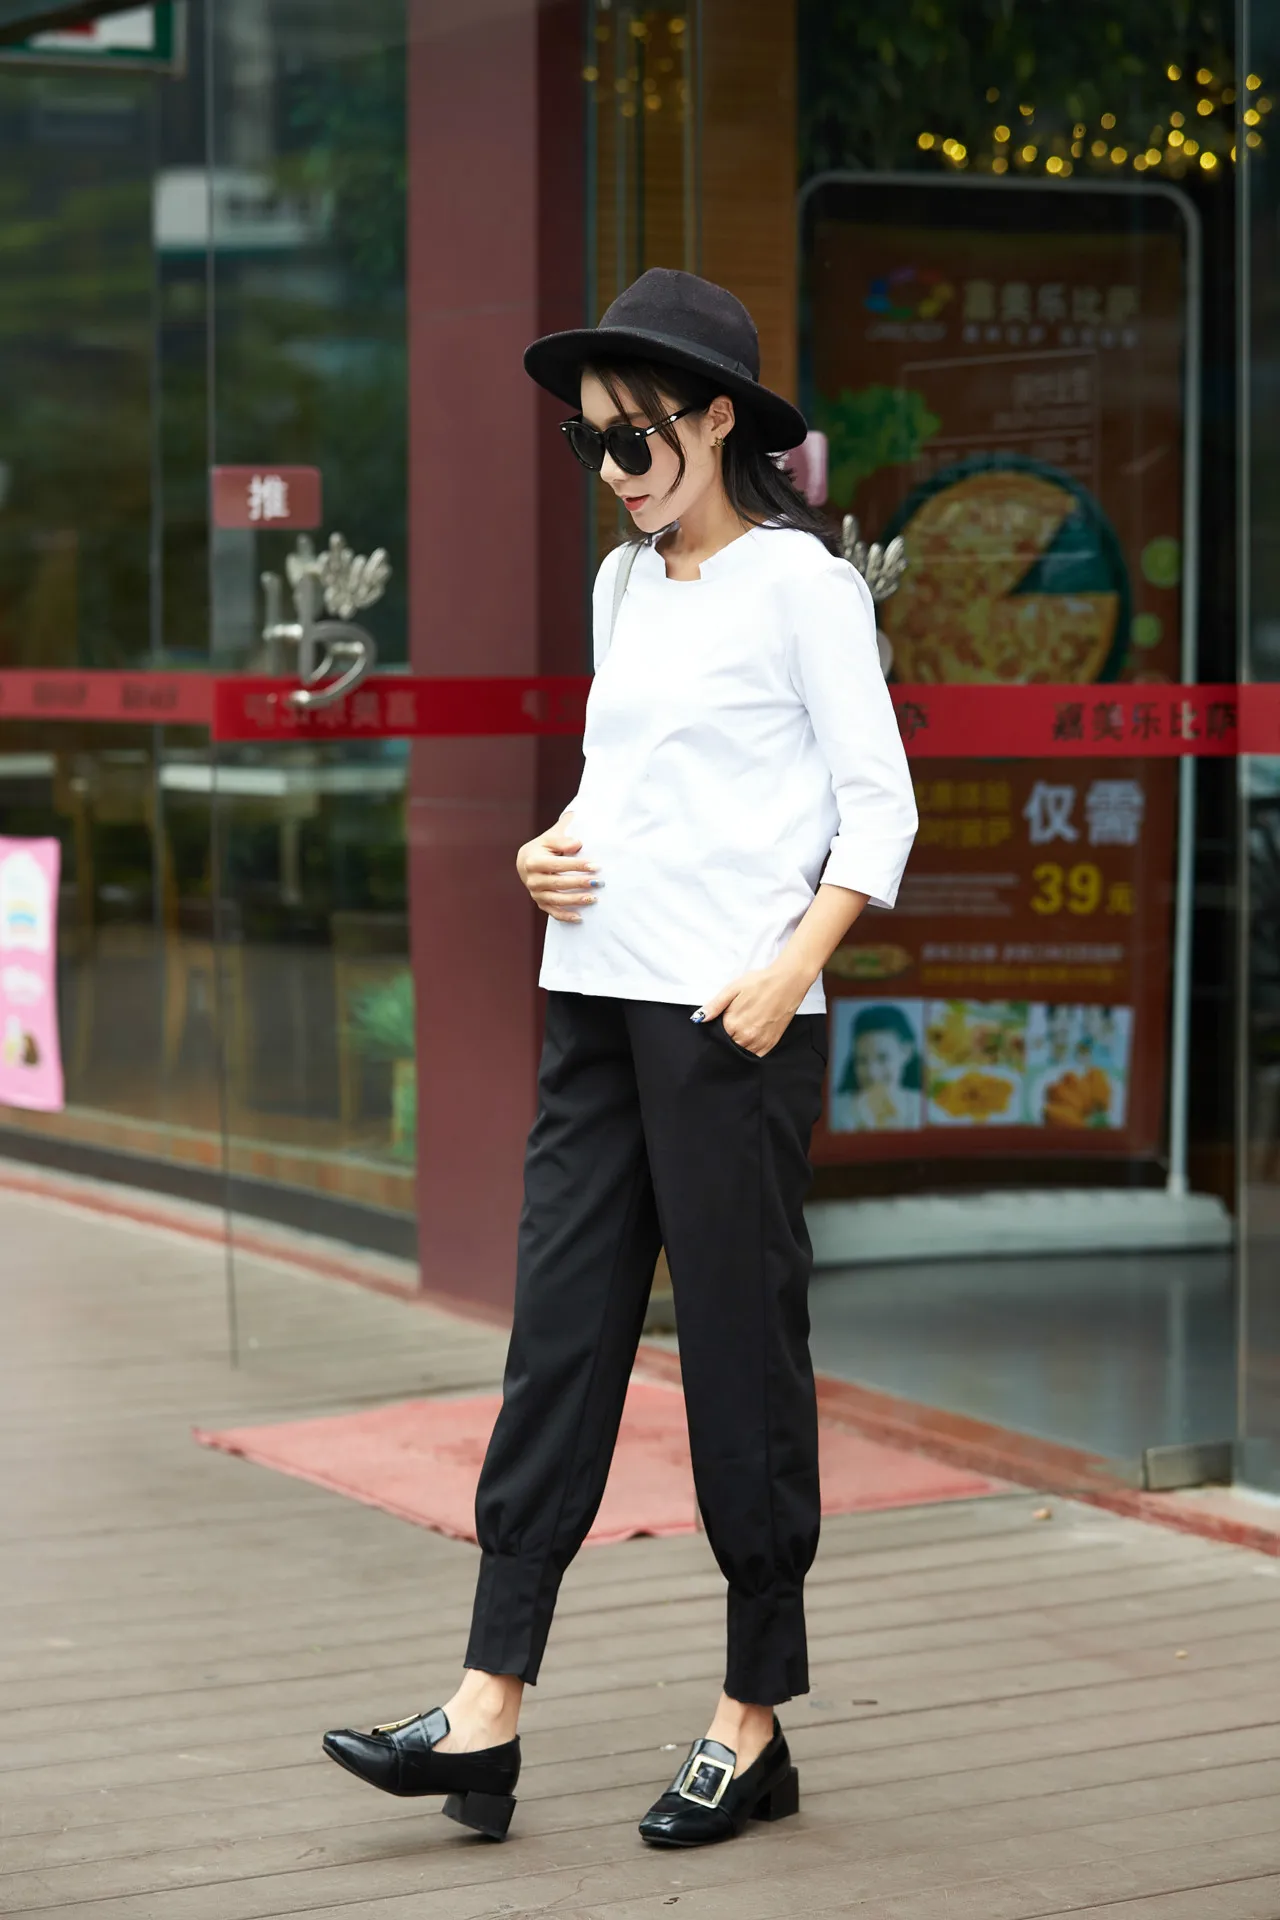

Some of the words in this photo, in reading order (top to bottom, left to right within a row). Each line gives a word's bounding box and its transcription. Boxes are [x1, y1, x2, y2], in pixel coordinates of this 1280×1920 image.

[247, 474, 290, 521] 推
[1052, 701, 1237, 742] 嘉美乐比萨
[1022, 779, 1145, 847] 仅需
